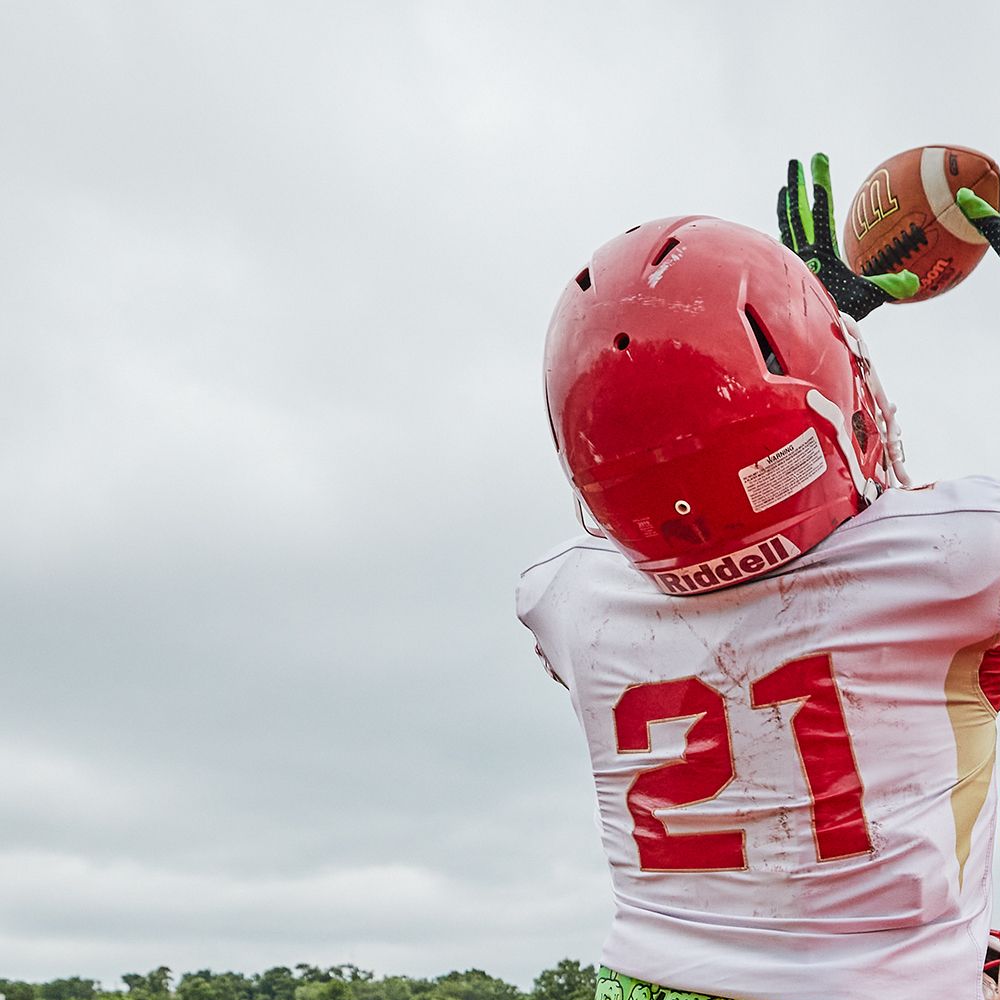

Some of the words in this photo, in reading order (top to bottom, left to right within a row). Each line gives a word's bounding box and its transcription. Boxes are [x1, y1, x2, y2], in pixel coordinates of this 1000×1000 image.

[766, 444, 795, 465] WARNING
[659, 536, 790, 593] Riddell
[612, 651, 876, 873] 21
